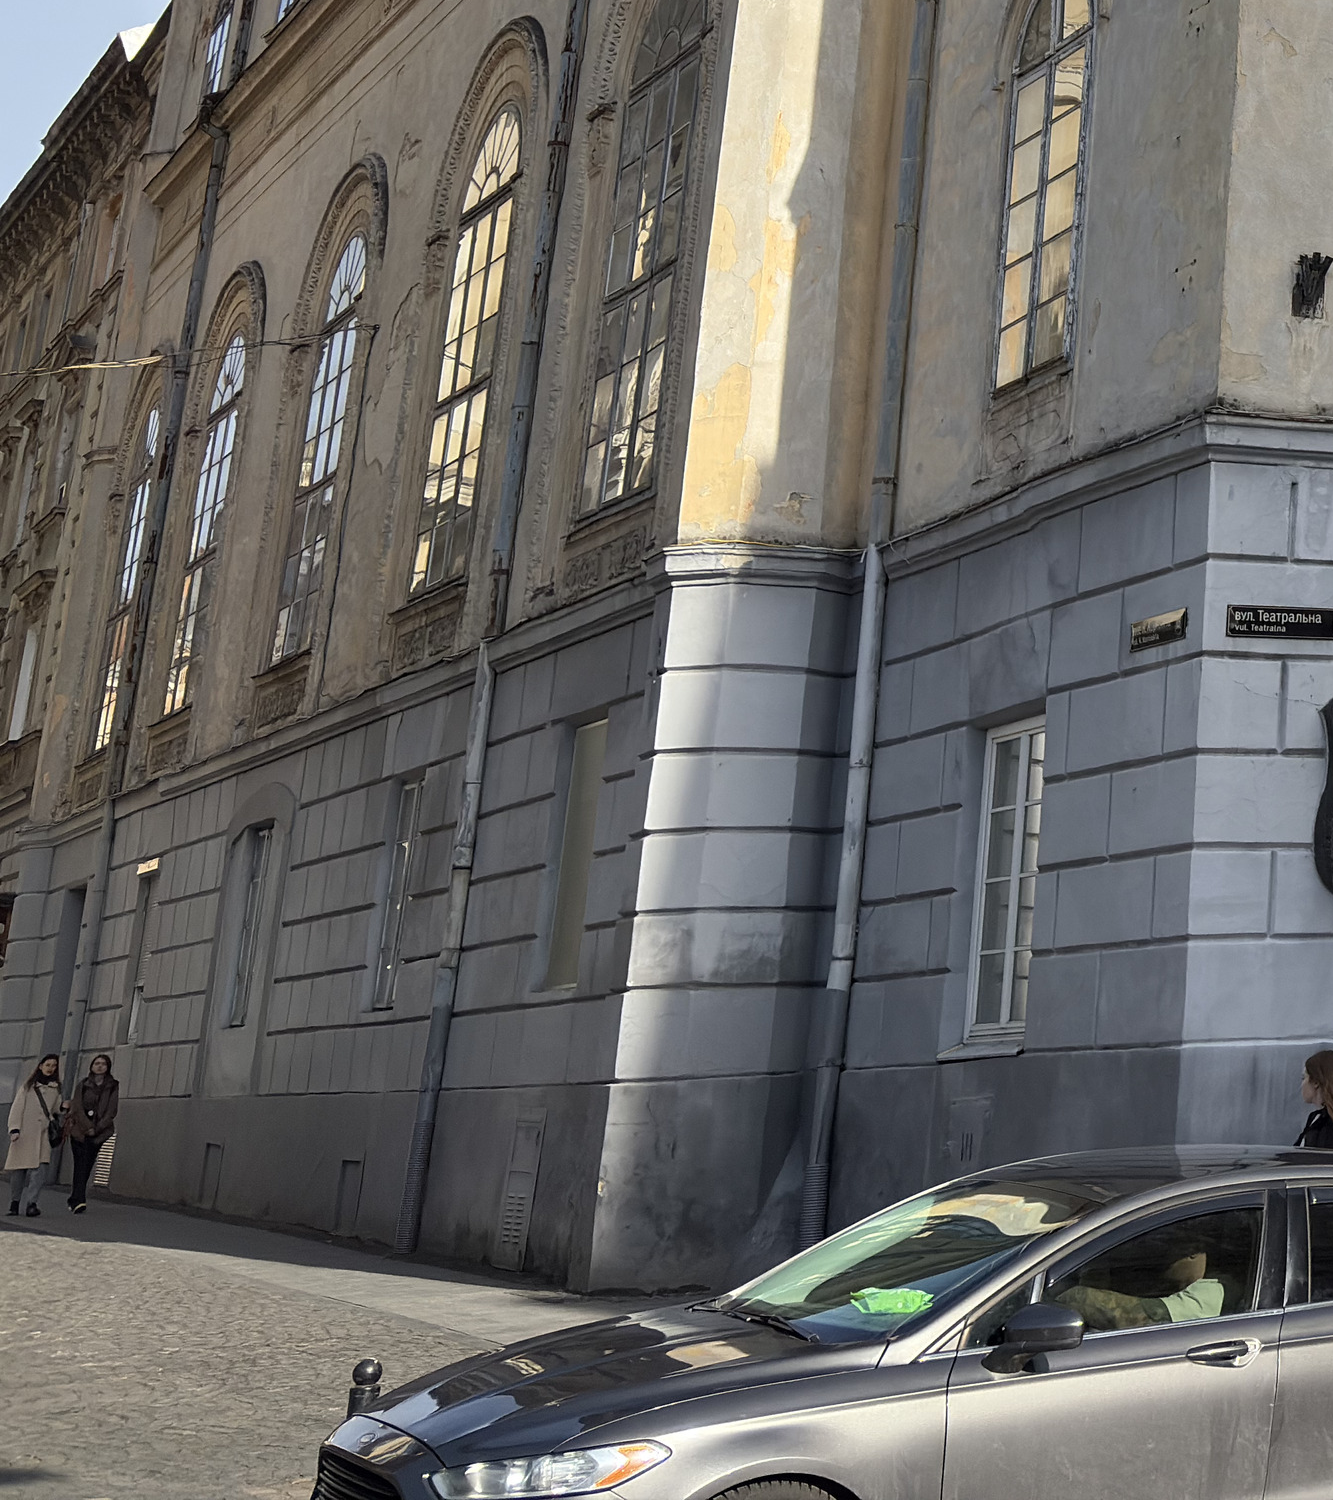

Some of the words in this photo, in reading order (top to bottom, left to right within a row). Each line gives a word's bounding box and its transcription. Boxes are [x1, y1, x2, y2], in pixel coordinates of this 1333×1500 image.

[1234, 610, 1255, 622] вул.
[1257, 609, 1322, 625] Театральна
[1251, 623, 1286, 633] Teatralna
